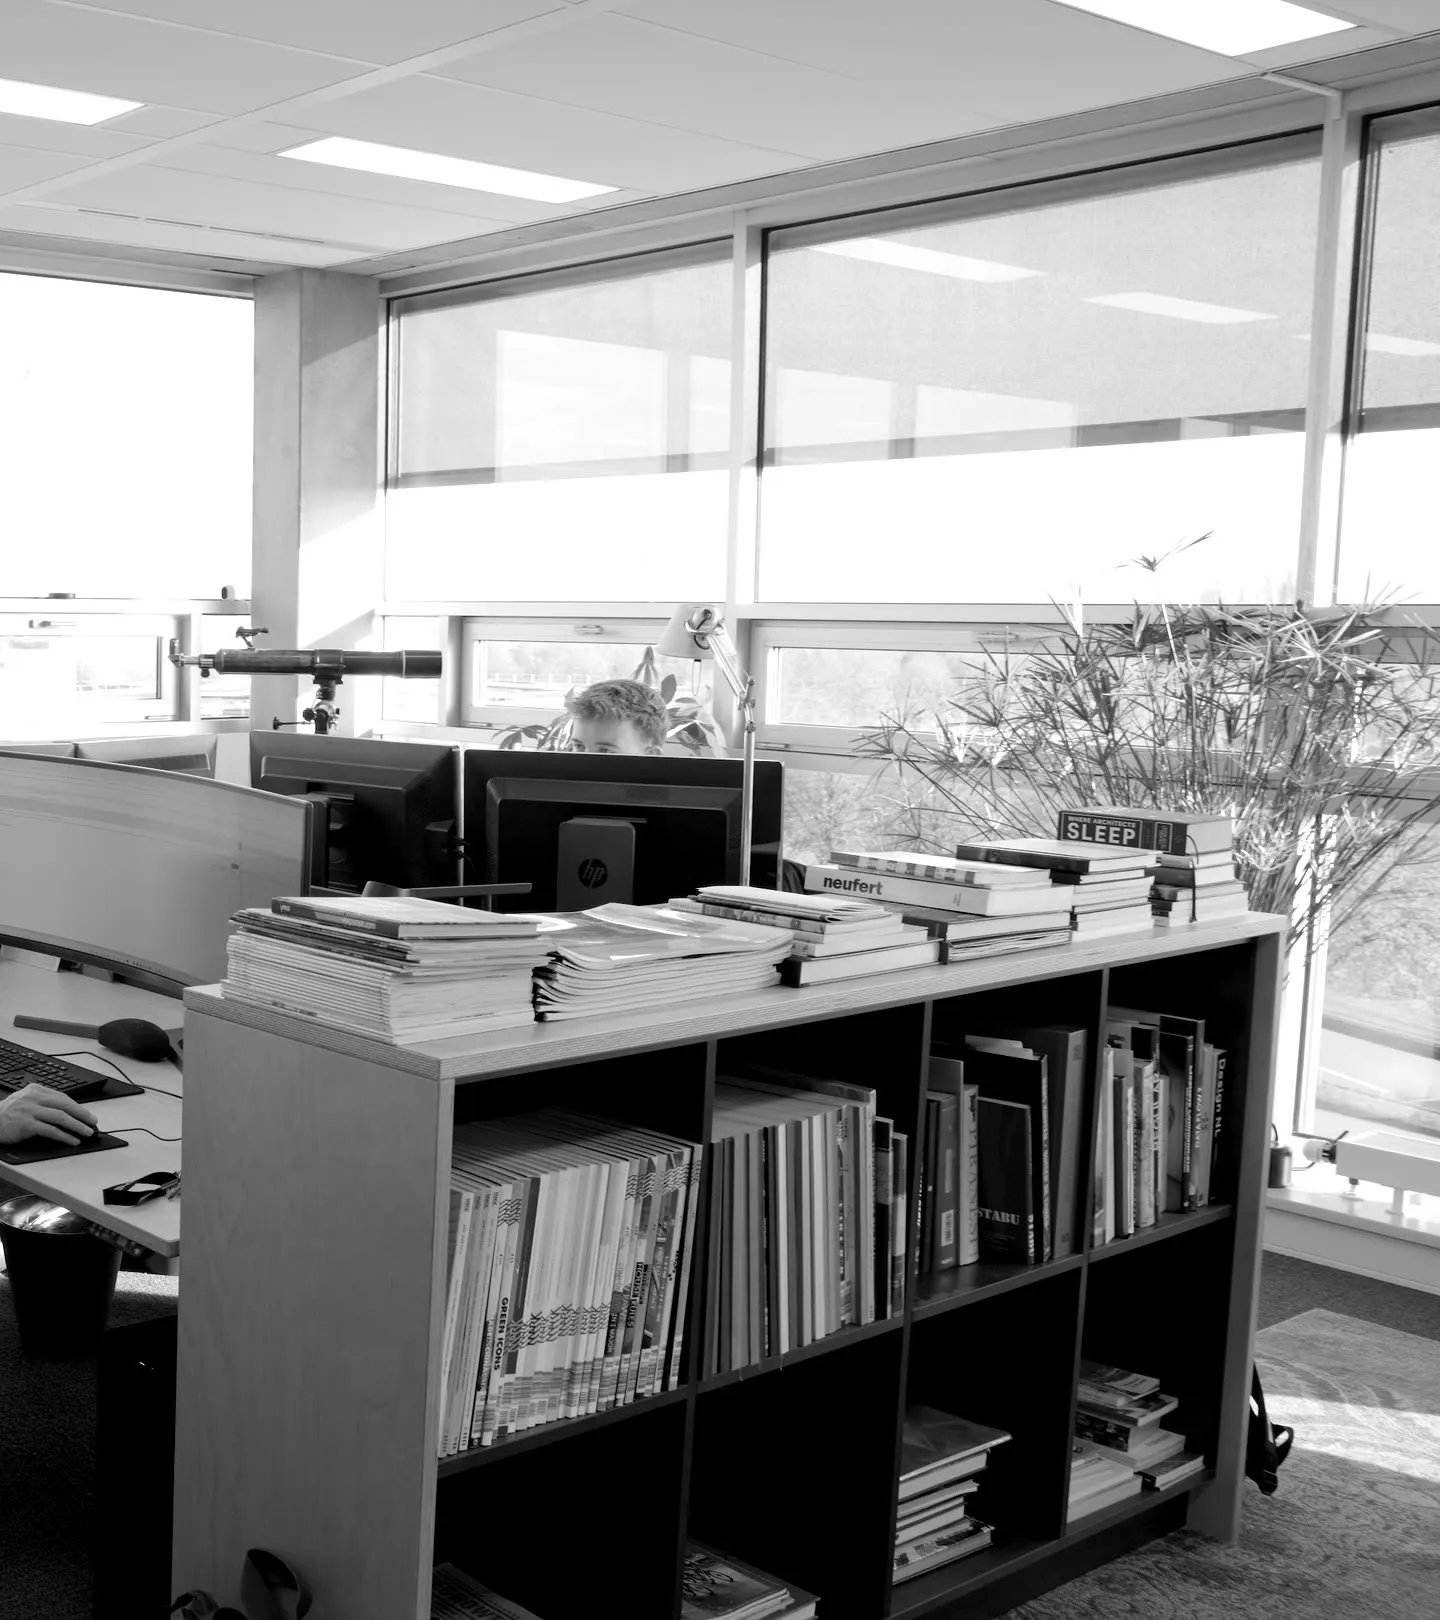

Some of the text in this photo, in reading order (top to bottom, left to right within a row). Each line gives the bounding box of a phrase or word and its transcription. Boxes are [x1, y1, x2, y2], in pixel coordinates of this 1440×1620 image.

[1066, 822, 1136, 845] SLEEP
[1093, 818, 1137, 829] ARCHITECTS
[582, 859, 606, 888] hp
[823, 876, 884, 896] neufert
[632, 1262, 644, 1298] HOUSE
[493, 1297, 509, 1371] GREEN ICONS
